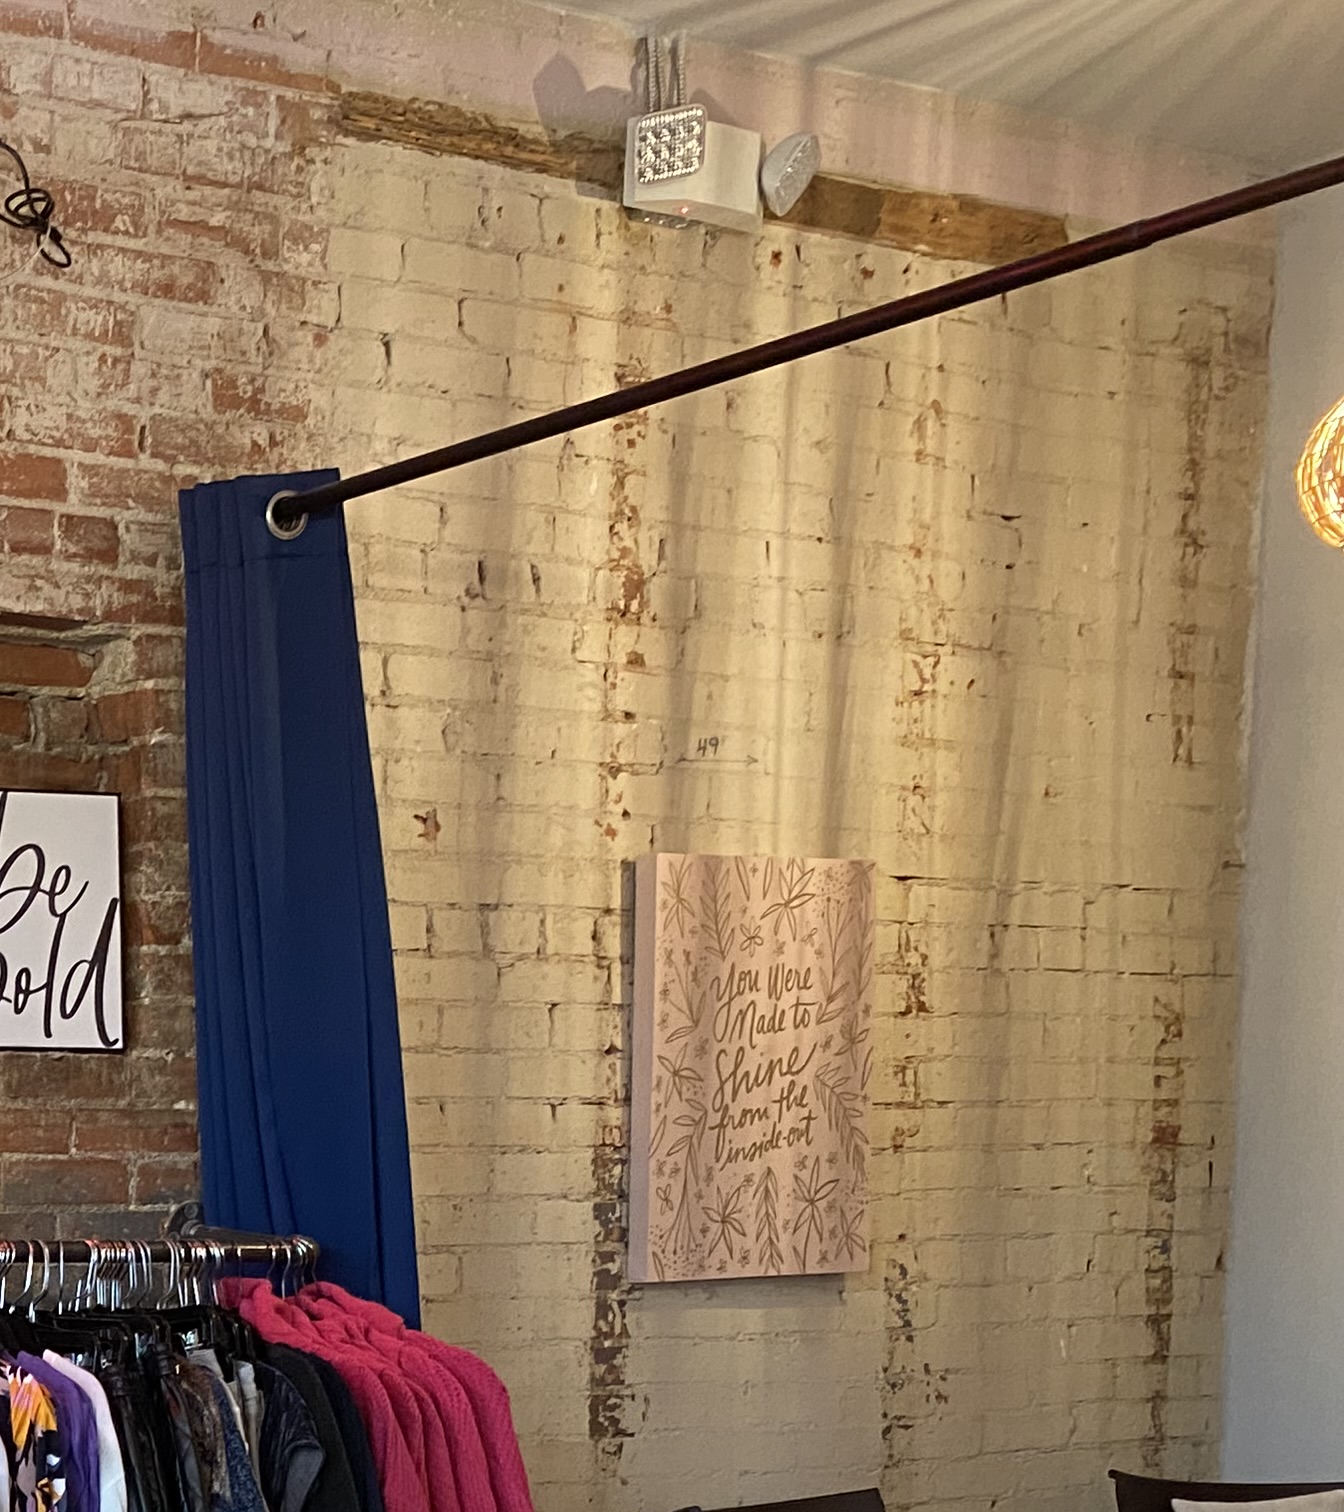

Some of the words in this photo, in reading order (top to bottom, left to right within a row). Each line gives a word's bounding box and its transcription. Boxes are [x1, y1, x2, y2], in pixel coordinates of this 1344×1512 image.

[709, 961, 761, 1043] You
[767, 962, 813, 1001] Were
[728, 1000, 786, 1049] Made
[788, 996, 818, 1029] to
[712, 1042, 818, 1114] Shine
[708, 1103, 770, 1164] from
[771, 1079, 810, 1124] the
[719, 1108, 818, 1172] inside-out
